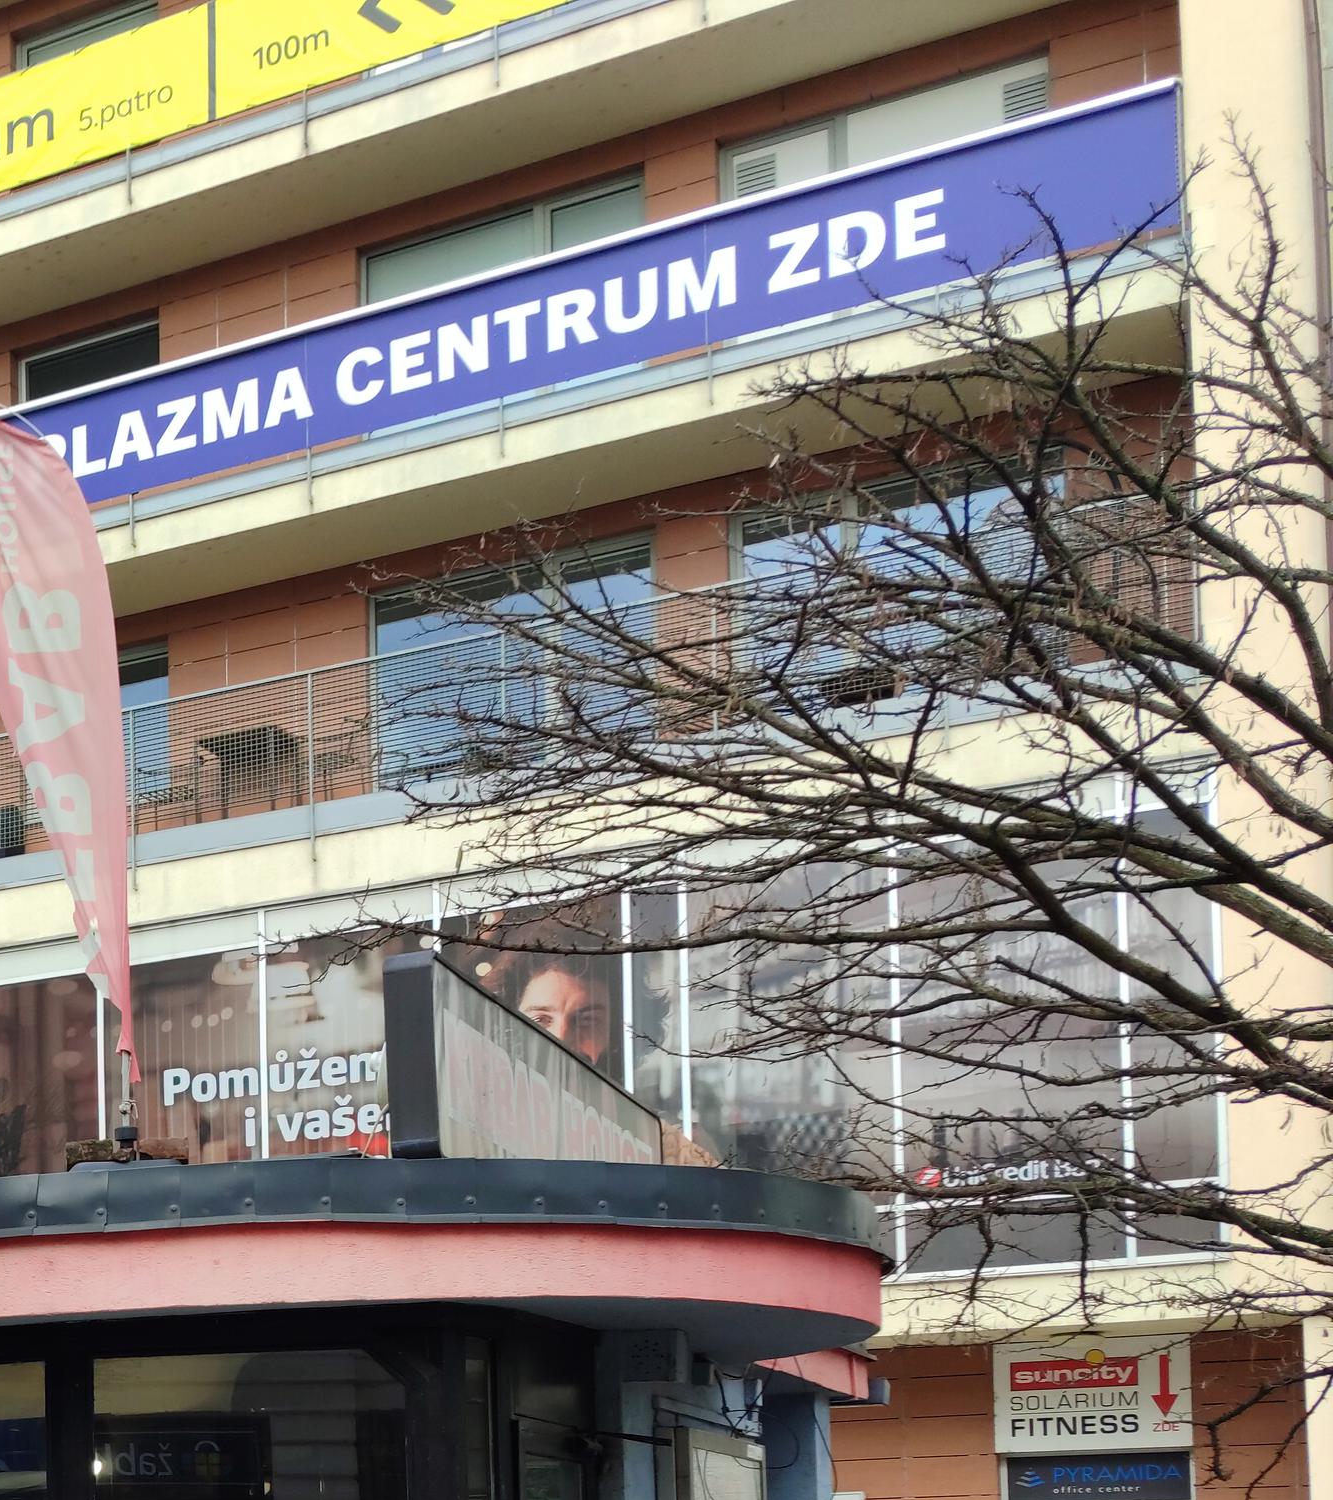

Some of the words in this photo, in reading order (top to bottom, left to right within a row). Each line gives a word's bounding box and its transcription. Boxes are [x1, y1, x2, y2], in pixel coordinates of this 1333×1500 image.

[252, 29, 330, 69] 100m
[78, 82, 174, 134] 5.patro
[334, 246, 734, 406] CENTRUM
[767, 187, 946, 295] ZDE
[244, 1107, 256, 1147] i
[276, 1094, 391, 1143] vaše
[1014, 1359, 1134, 1384] suncity
[1010, 1391, 1139, 1411] SOLÁRIUM
[1011, 1414, 1139, 1437] FITNESS
[1152, 1421, 1180, 1433] ZDE
[1052, 1464, 1182, 1483] PYRAMIDA
[1053, 1485, 1092, 1494] office
[1098, 1484, 1141, 1493] center
